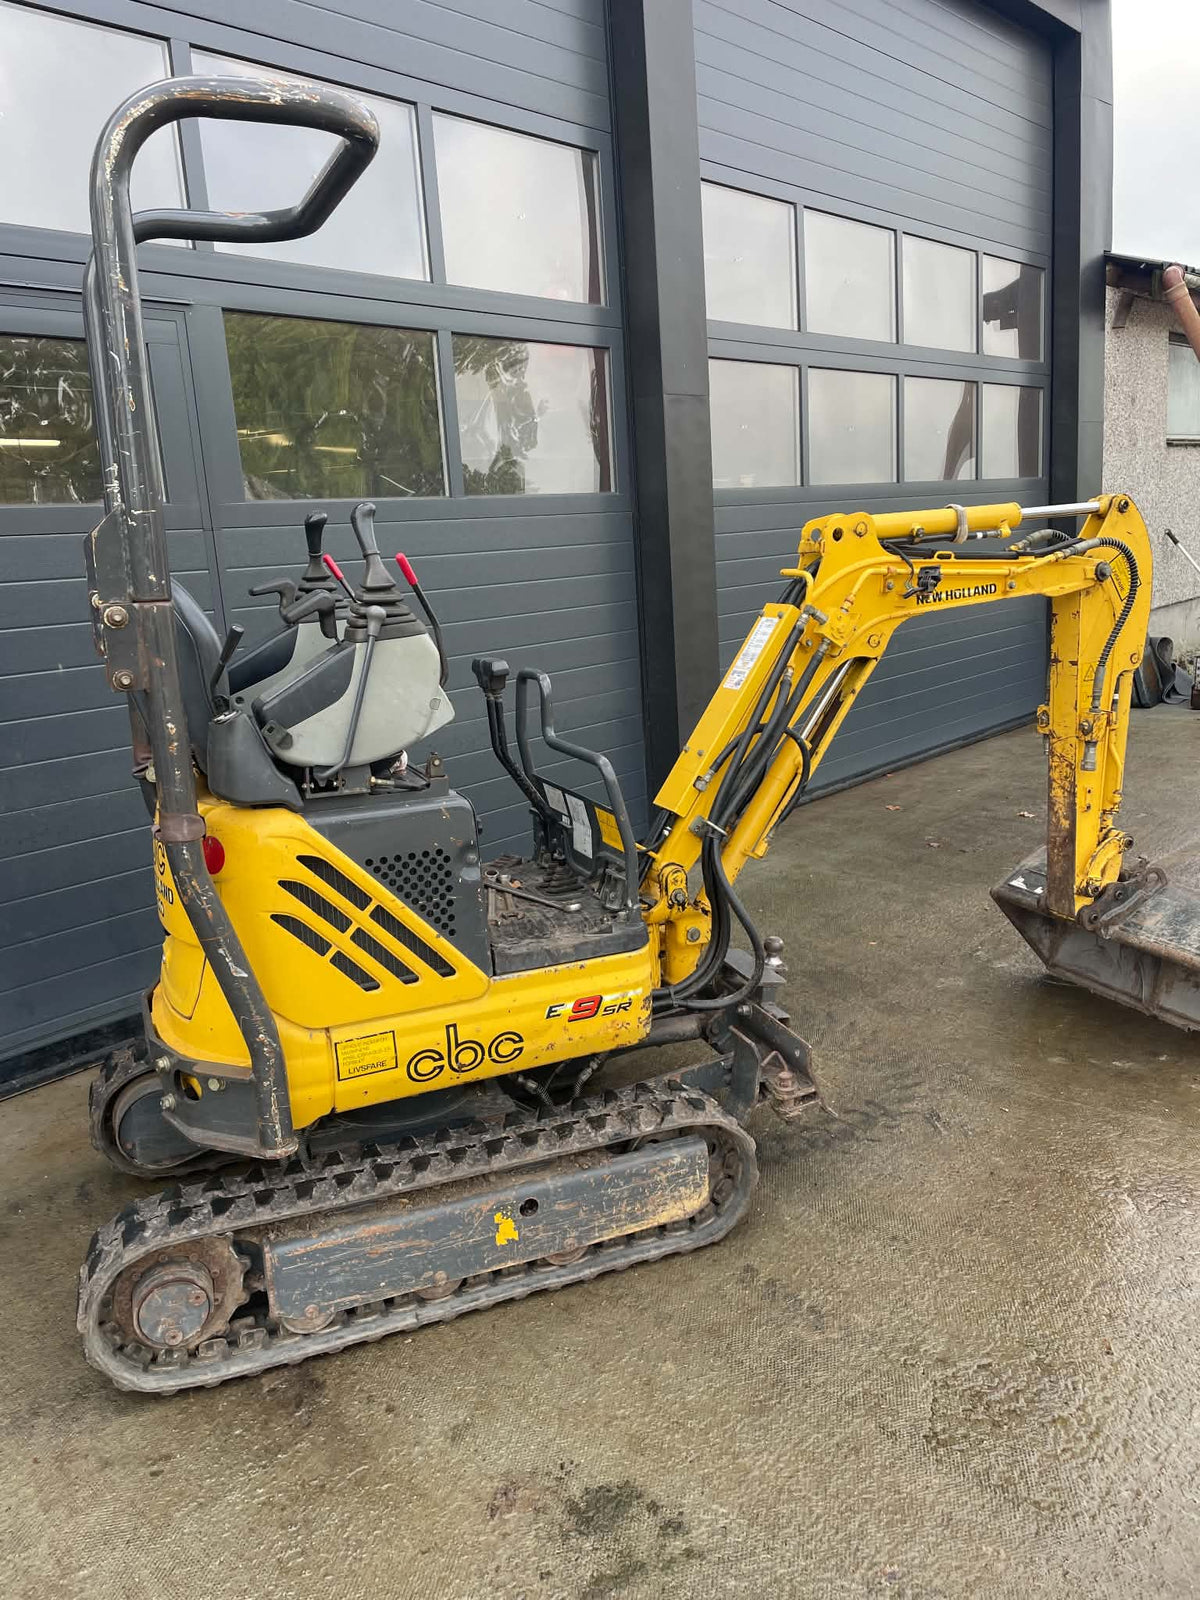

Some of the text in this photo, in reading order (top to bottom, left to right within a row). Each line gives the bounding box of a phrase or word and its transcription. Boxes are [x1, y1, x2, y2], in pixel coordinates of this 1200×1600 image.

[916, 583, 997, 605] NEW HOLLAND
[406, 1023, 524, 1083] cbc
[348, 1060, 387, 1075] LIVSFARE
